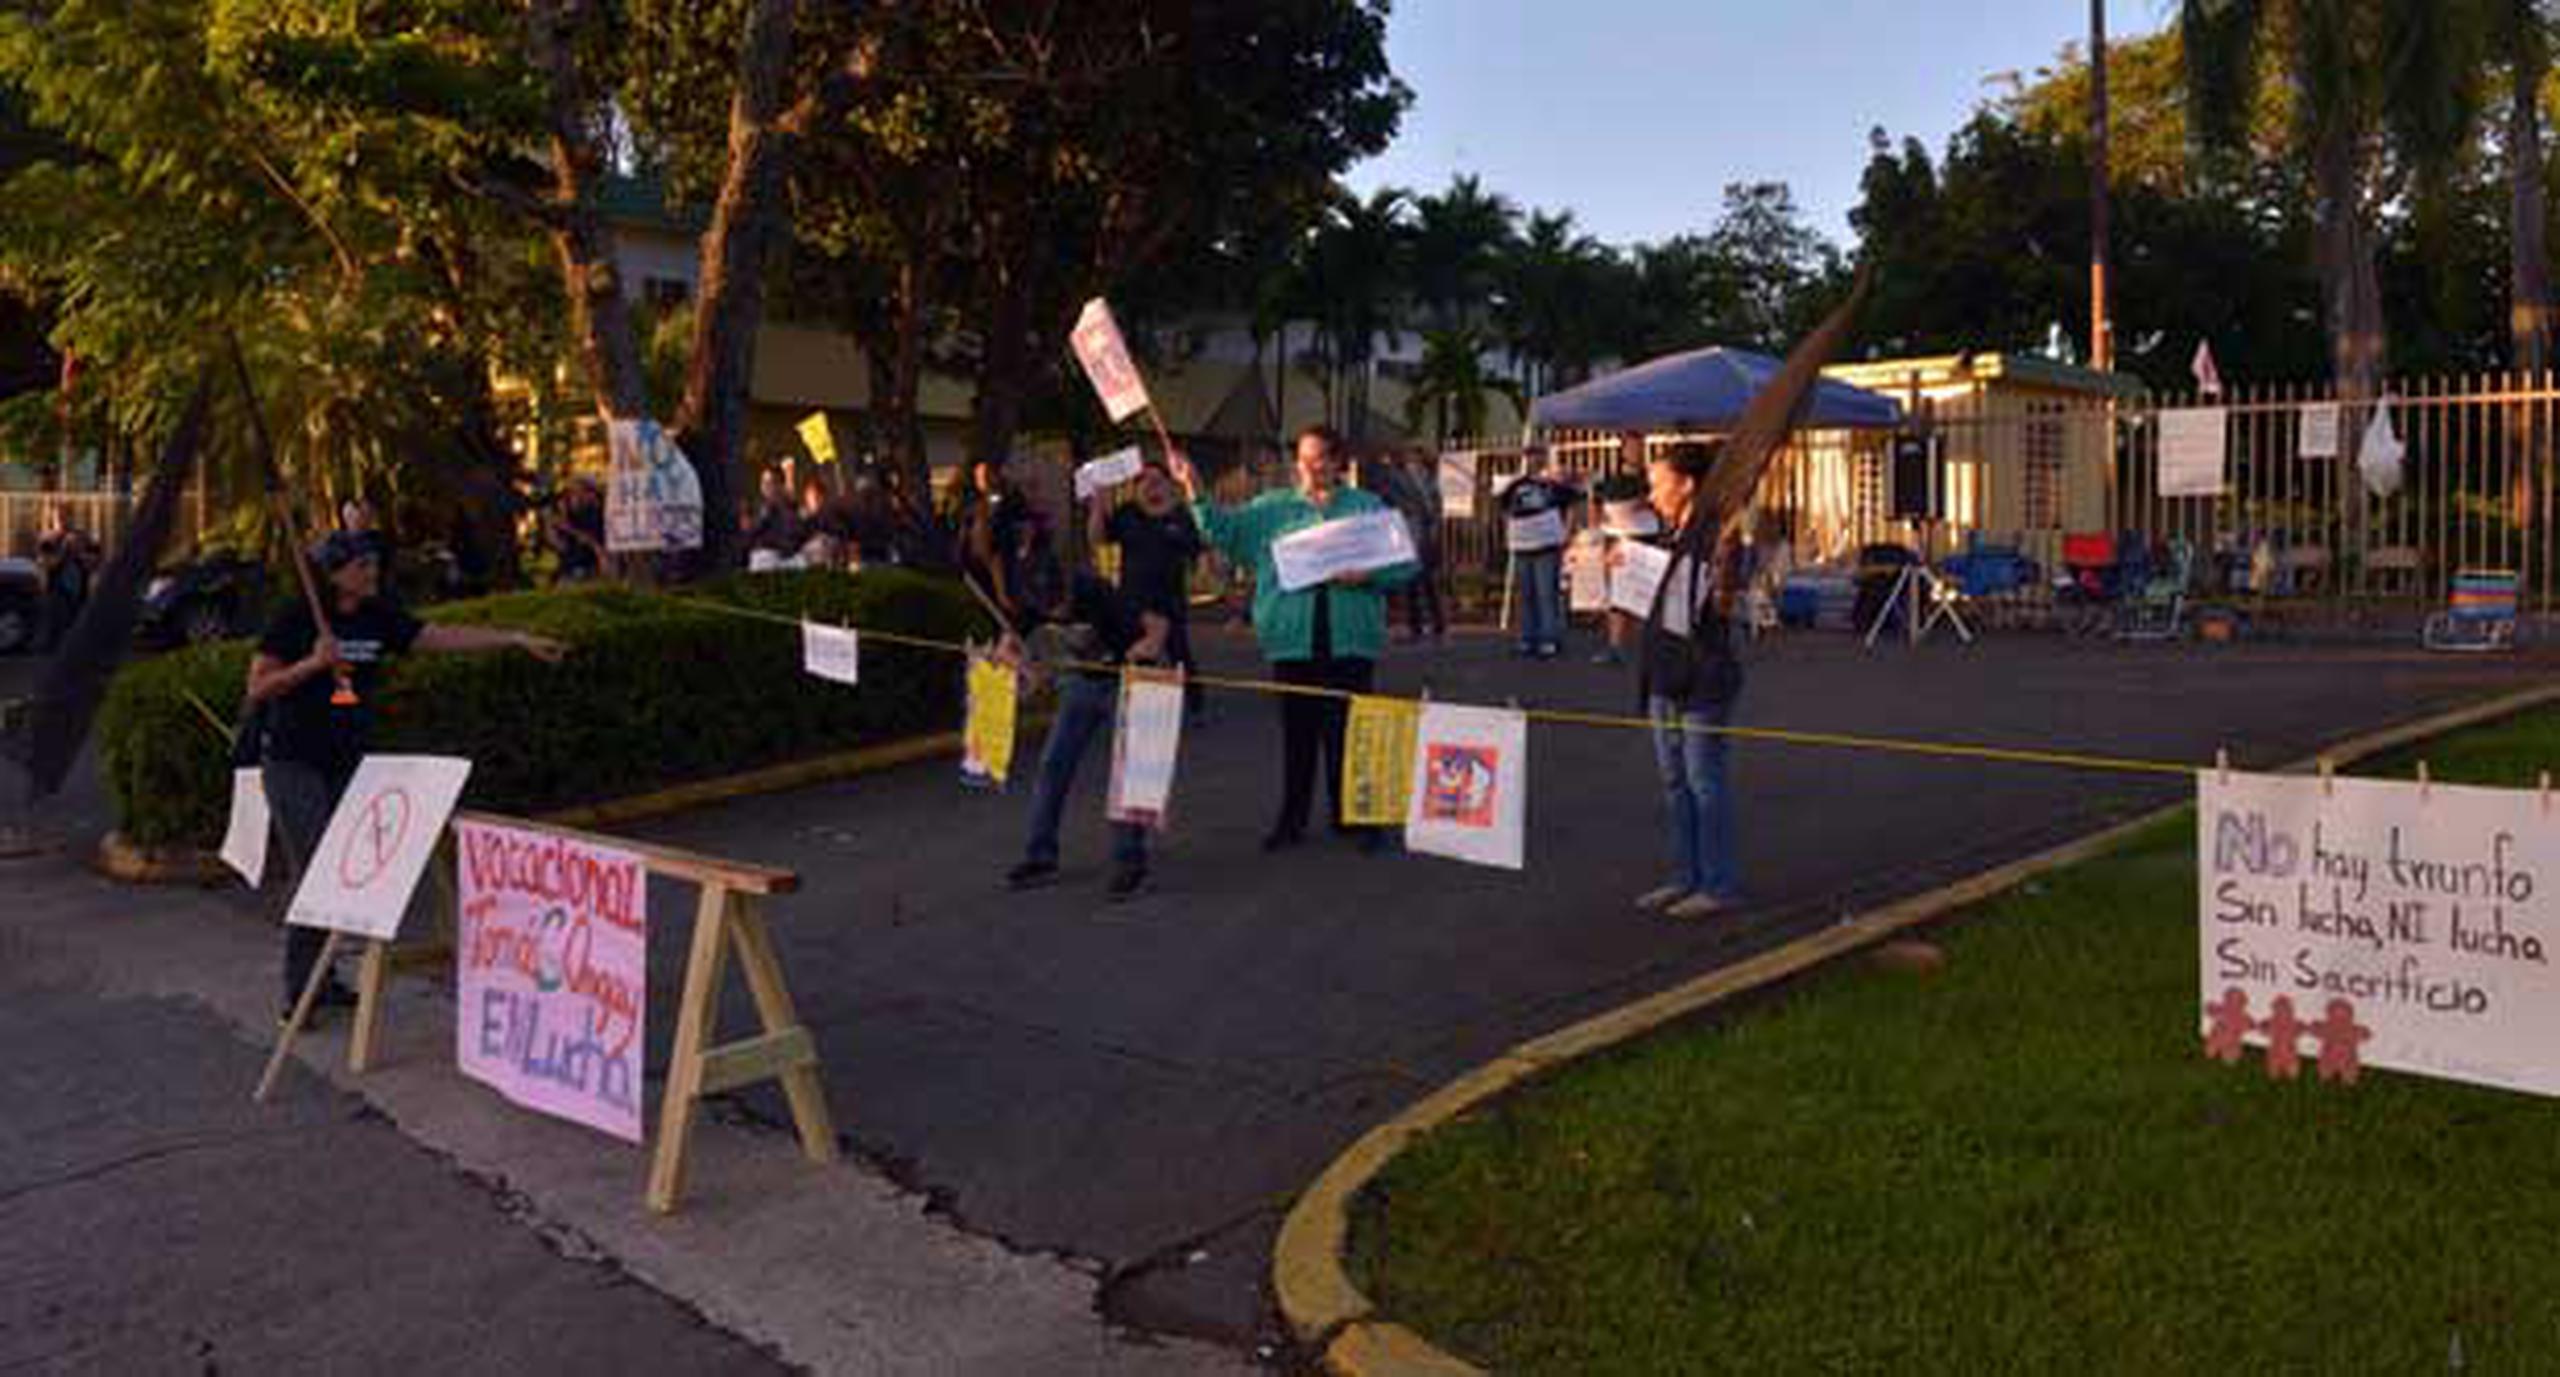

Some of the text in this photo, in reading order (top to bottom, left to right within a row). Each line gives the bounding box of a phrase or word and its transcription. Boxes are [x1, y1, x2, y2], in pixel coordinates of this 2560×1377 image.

[2215, 811, 2533, 901] No hay triunfo
[2215, 880, 2278, 926] Sin
[2389, 902, 2433, 944] NI
[2451, 904, 2549, 966] lucha
[2215, 937, 2278, 985] Sin
